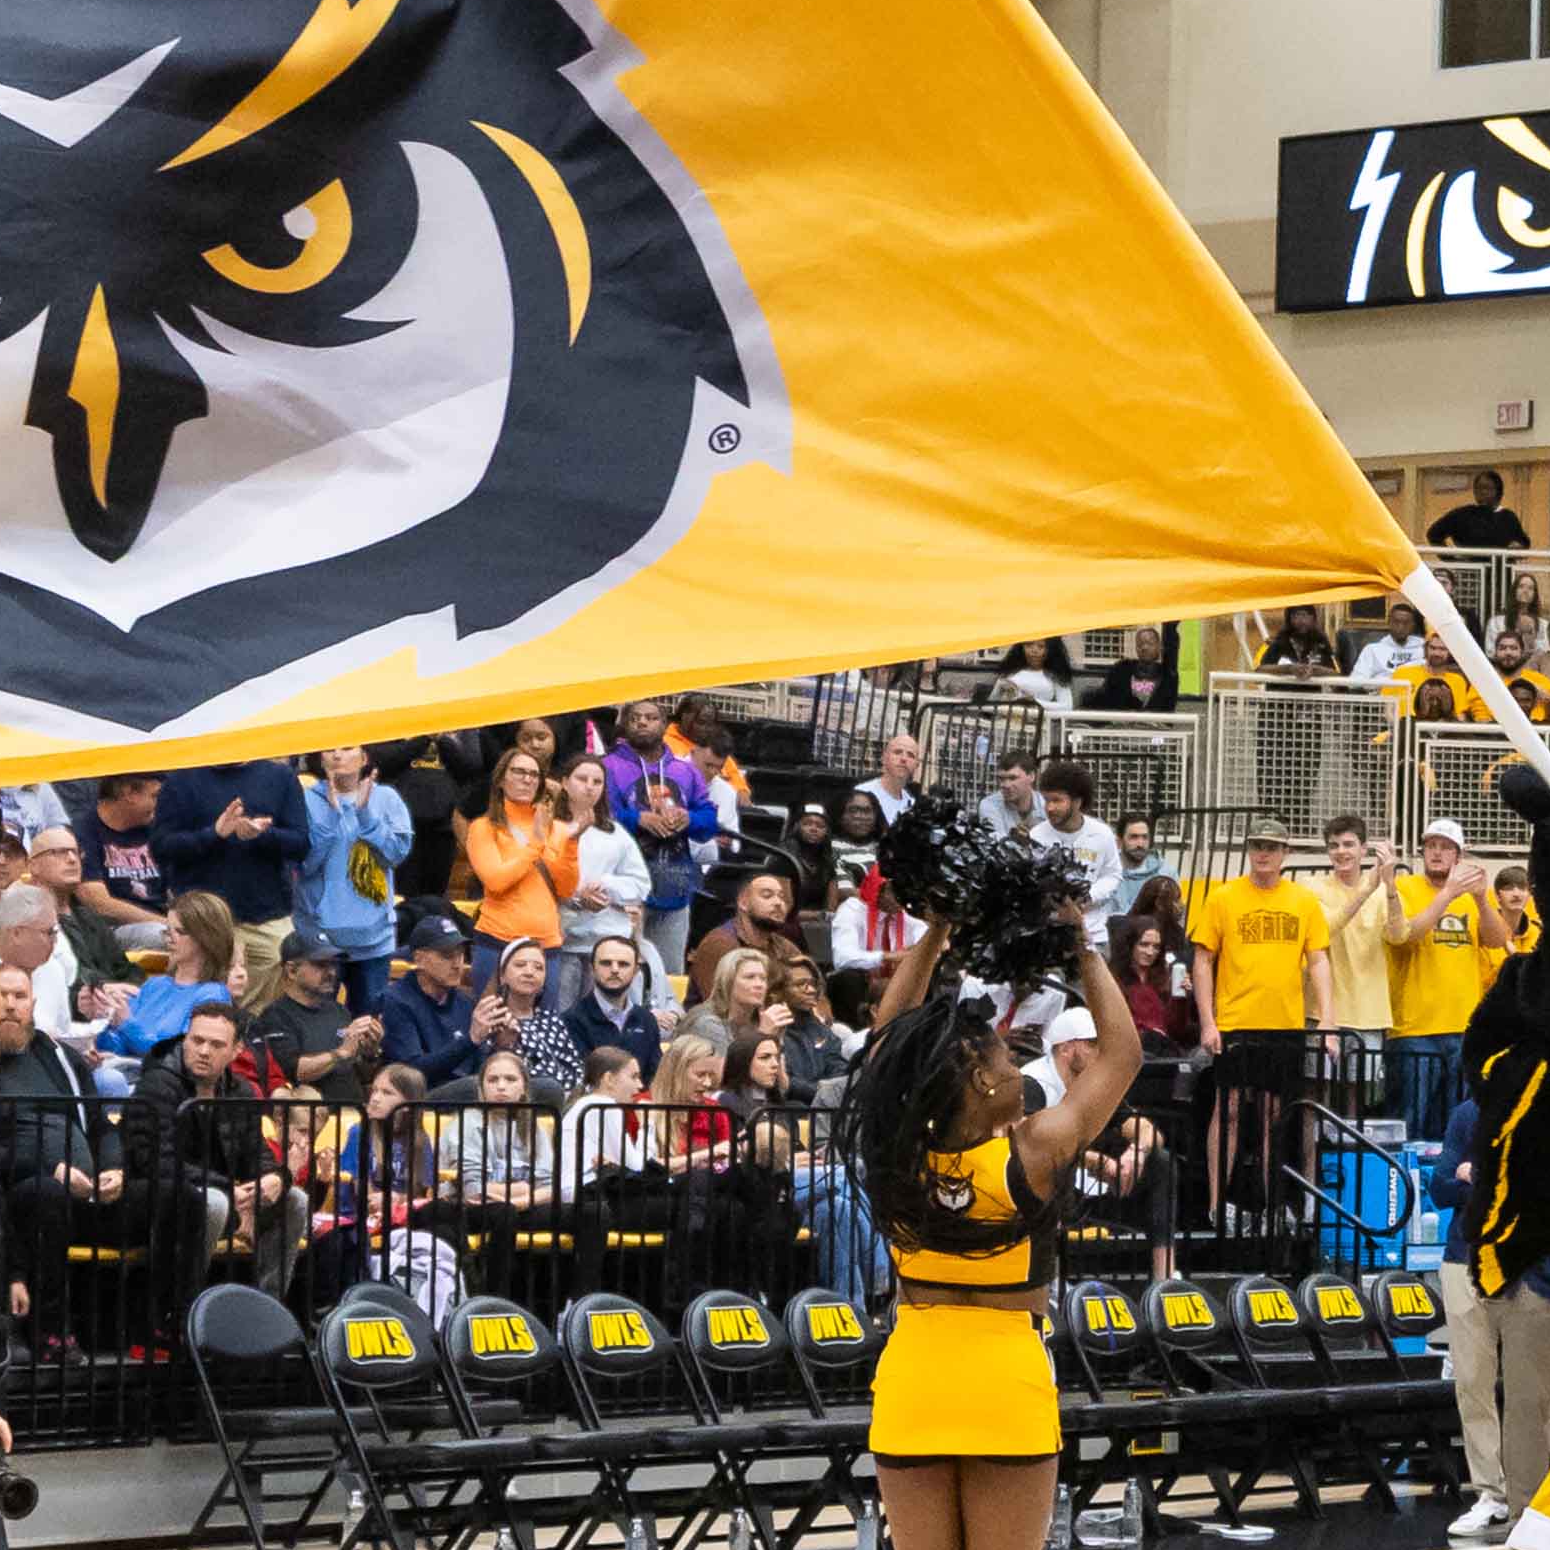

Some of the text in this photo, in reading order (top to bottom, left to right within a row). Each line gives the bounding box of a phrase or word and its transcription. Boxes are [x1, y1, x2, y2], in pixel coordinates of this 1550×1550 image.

[1497, 403, 1521, 426] EXIT
[1163, 1296, 1215, 1327] OWLS
[1249, 1291, 1297, 1323] OWLS
[1316, 1289, 1363, 1319] OWLS
[1390, 1286, 1433, 1315] OWLS
[346, 1320, 414, 1358] OWLS
[471, 1317, 536, 1354] OWLS
[590, 1312, 653, 1348] OWLS
[708, 1308, 768, 1344] OWLS
[808, 1304, 864, 1341] OWLS
